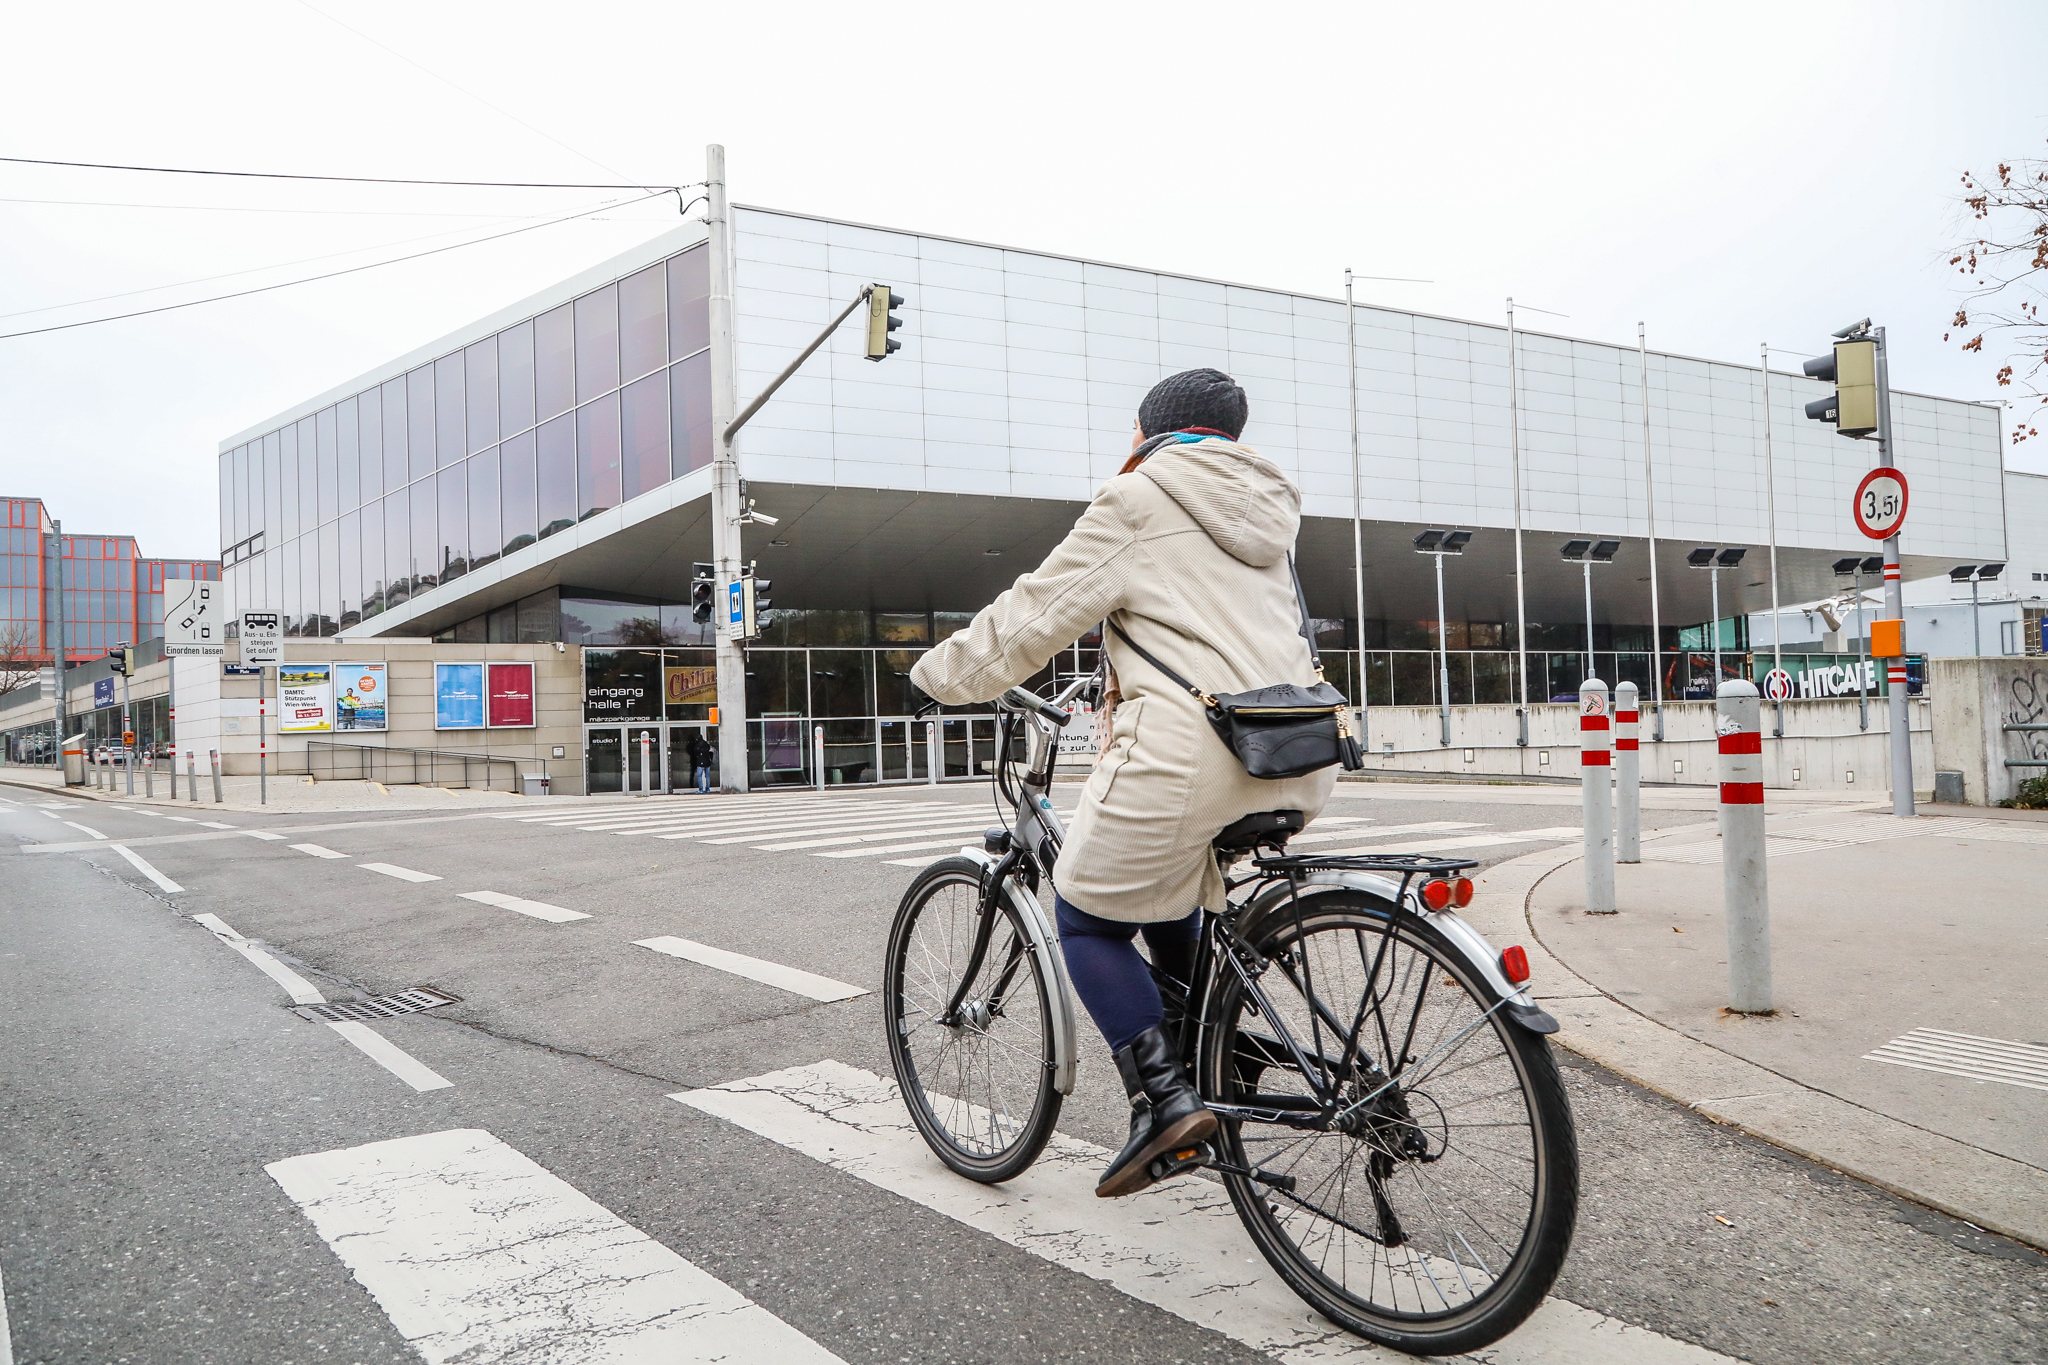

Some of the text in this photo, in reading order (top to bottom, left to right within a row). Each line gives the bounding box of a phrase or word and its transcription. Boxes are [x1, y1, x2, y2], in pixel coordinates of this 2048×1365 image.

[1864, 490, 1899, 521] 3,5t
[250, 639, 274, 647] steigen
[166, 646, 224, 655] Einordnen lassen
[258, 647, 278, 655] on/off
[588, 686, 644, 698] eingang
[589, 698, 636, 709] halle F
[590, 715, 650, 723] märzparkgarage
